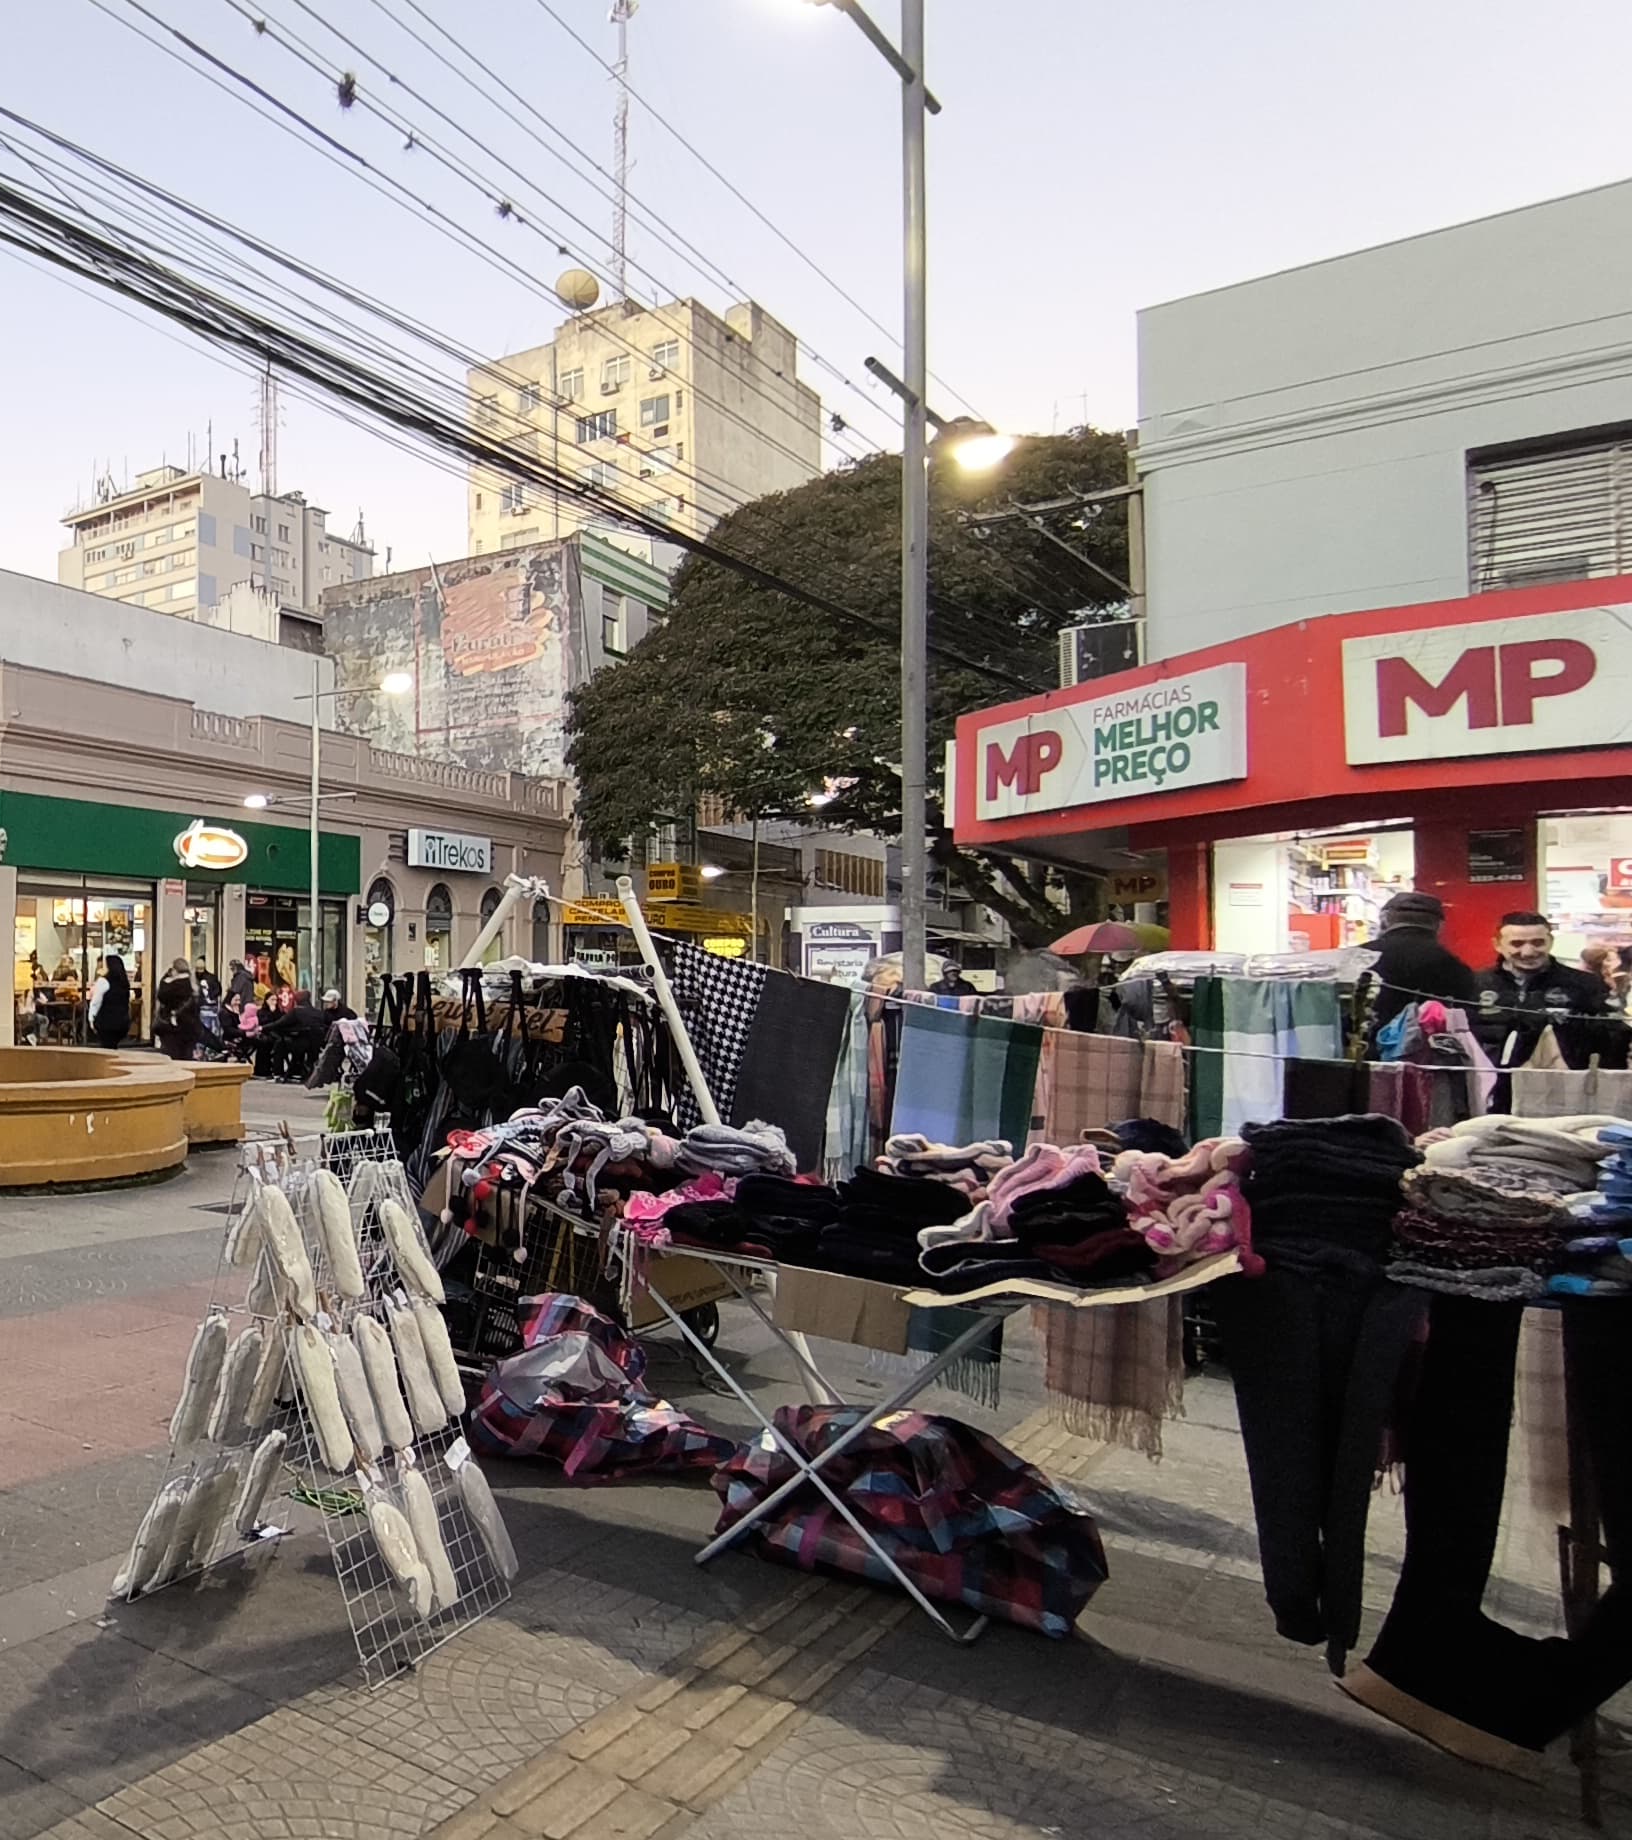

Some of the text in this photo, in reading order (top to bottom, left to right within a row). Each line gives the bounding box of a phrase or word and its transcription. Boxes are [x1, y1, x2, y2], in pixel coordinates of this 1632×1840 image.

[1093, 684, 1192, 724] FARMÁCIAS
[1375, 638, 1597, 738] MP
[1094, 700, 1220, 755] MELHOR
[985, 730, 1063, 801] MP
[1094, 742, 1191, 787] PREÇO
[437, 837, 485, 869] Trekos
[648, 879, 676, 891] OURO
[1114, 876, 1156, 895] MP
[811, 926, 860, 937] Cultura
